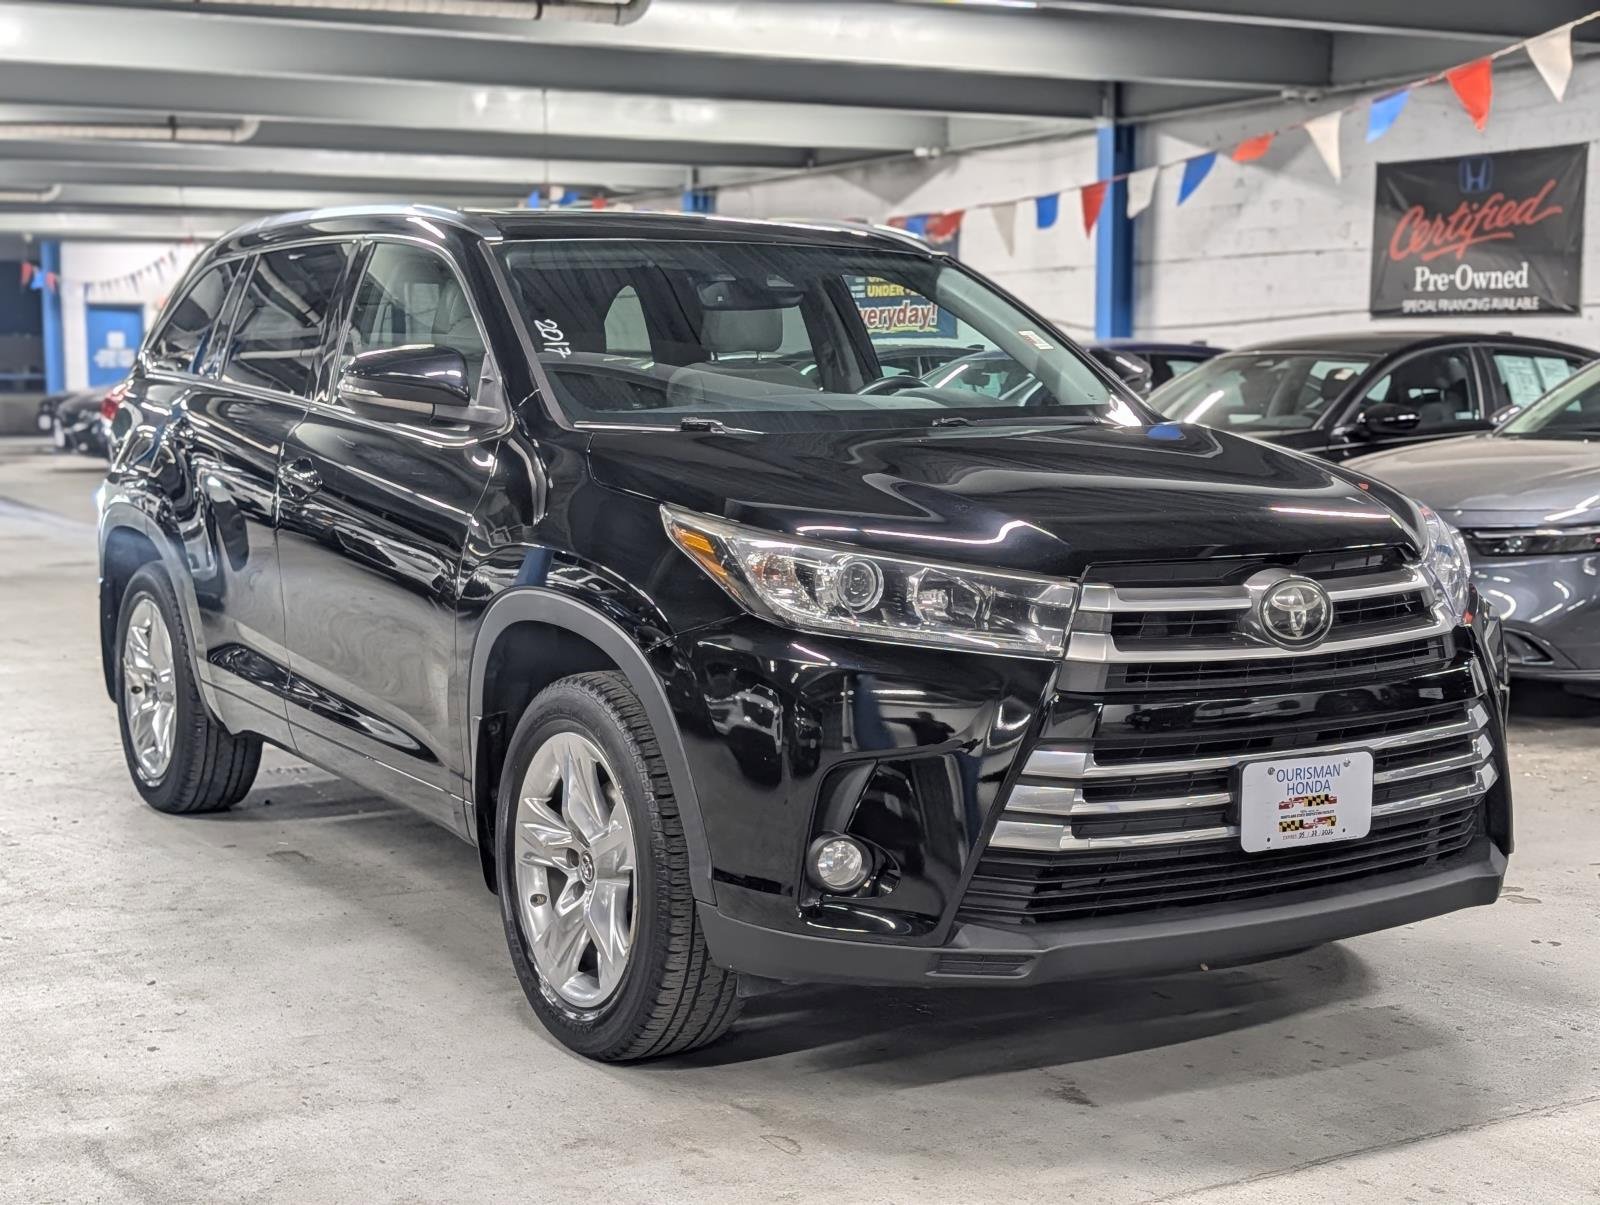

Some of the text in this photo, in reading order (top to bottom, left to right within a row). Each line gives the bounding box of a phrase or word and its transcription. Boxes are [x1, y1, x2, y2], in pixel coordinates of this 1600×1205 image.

[1389, 179, 1563, 260] Certified
[867, 284, 905, 297] UNDER
[1413, 261, 1529, 292] Pre-Owned
[858, 300, 938, 330] veryday!
[534, 319, 571, 358] 2017
[1276, 763, 1341, 782] OURISMAN
[1286, 779, 1331, 796] HONDA
